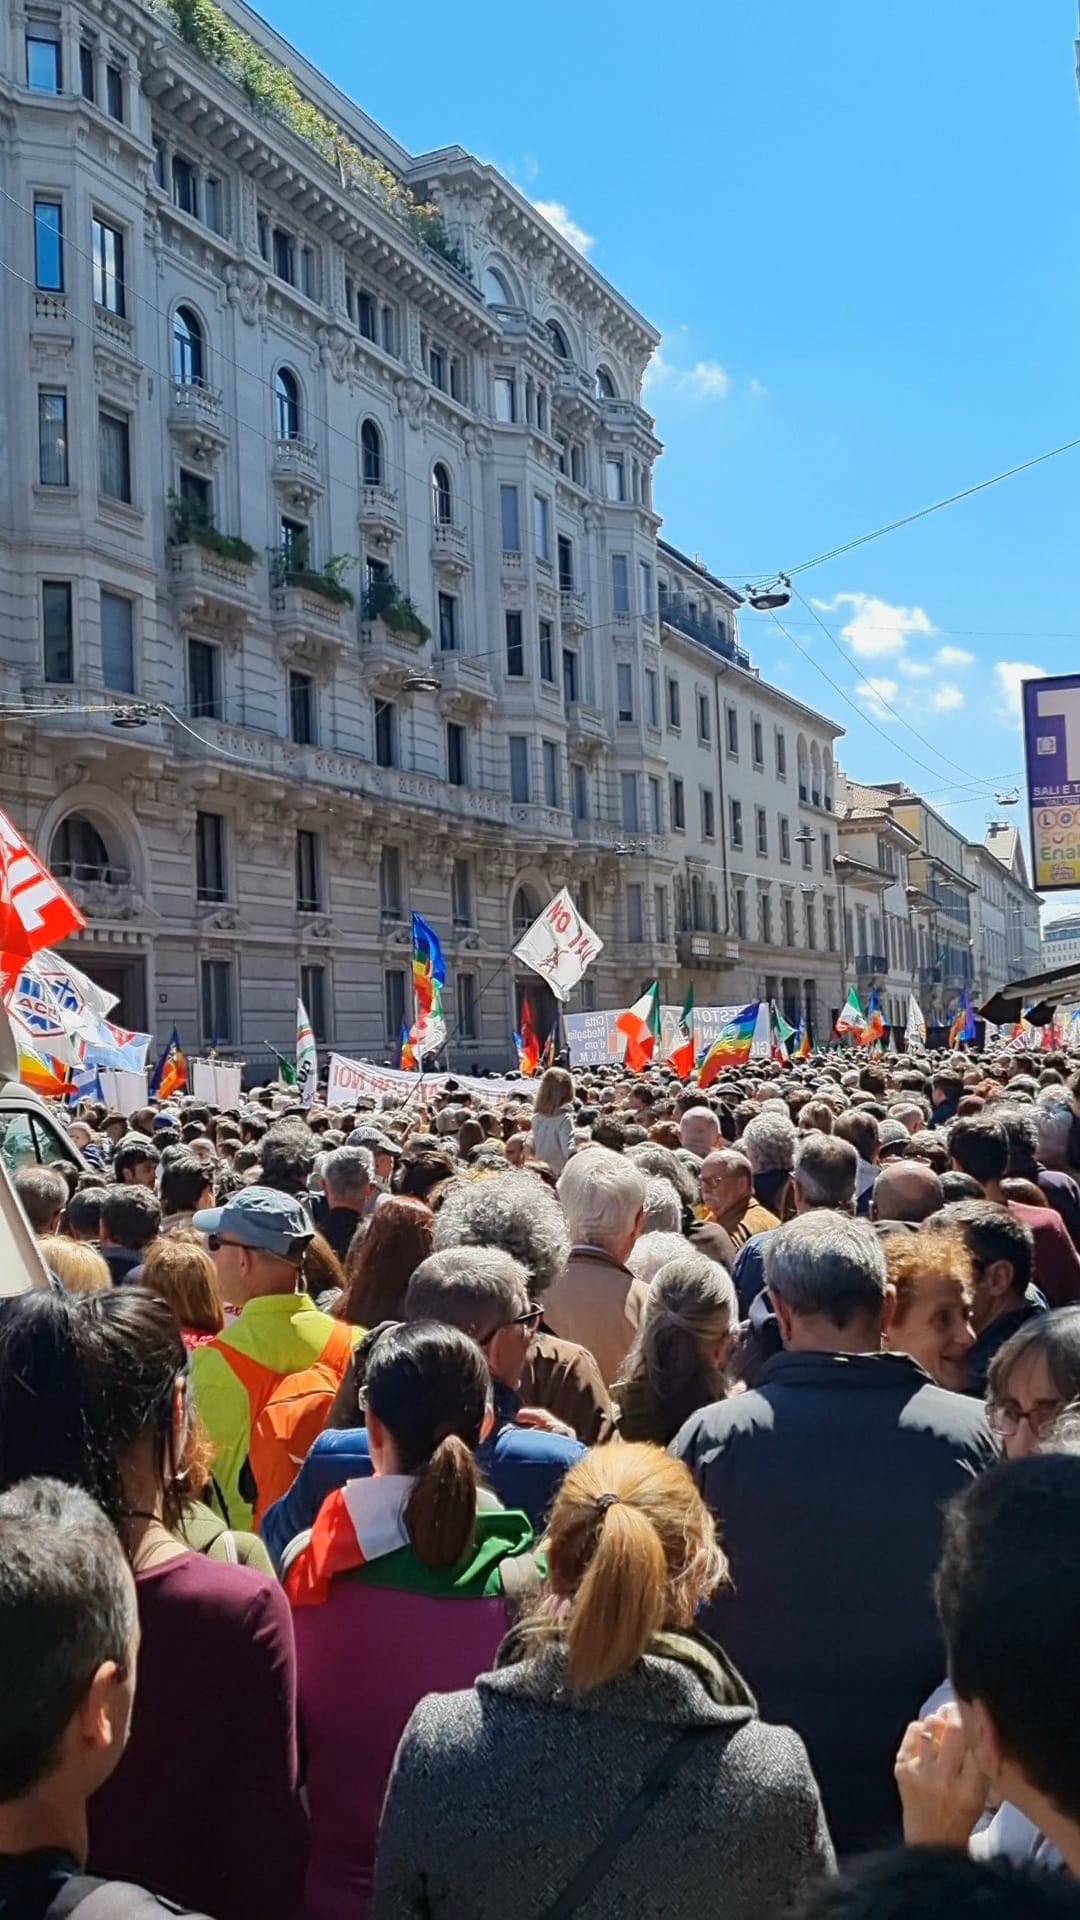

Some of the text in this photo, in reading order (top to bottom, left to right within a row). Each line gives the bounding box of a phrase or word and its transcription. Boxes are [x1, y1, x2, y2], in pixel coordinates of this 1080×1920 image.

[1033, 785, 1059, 796] SALI
[1063, 784, 1070, 794] E
[546, 899, 571, 933] NO
